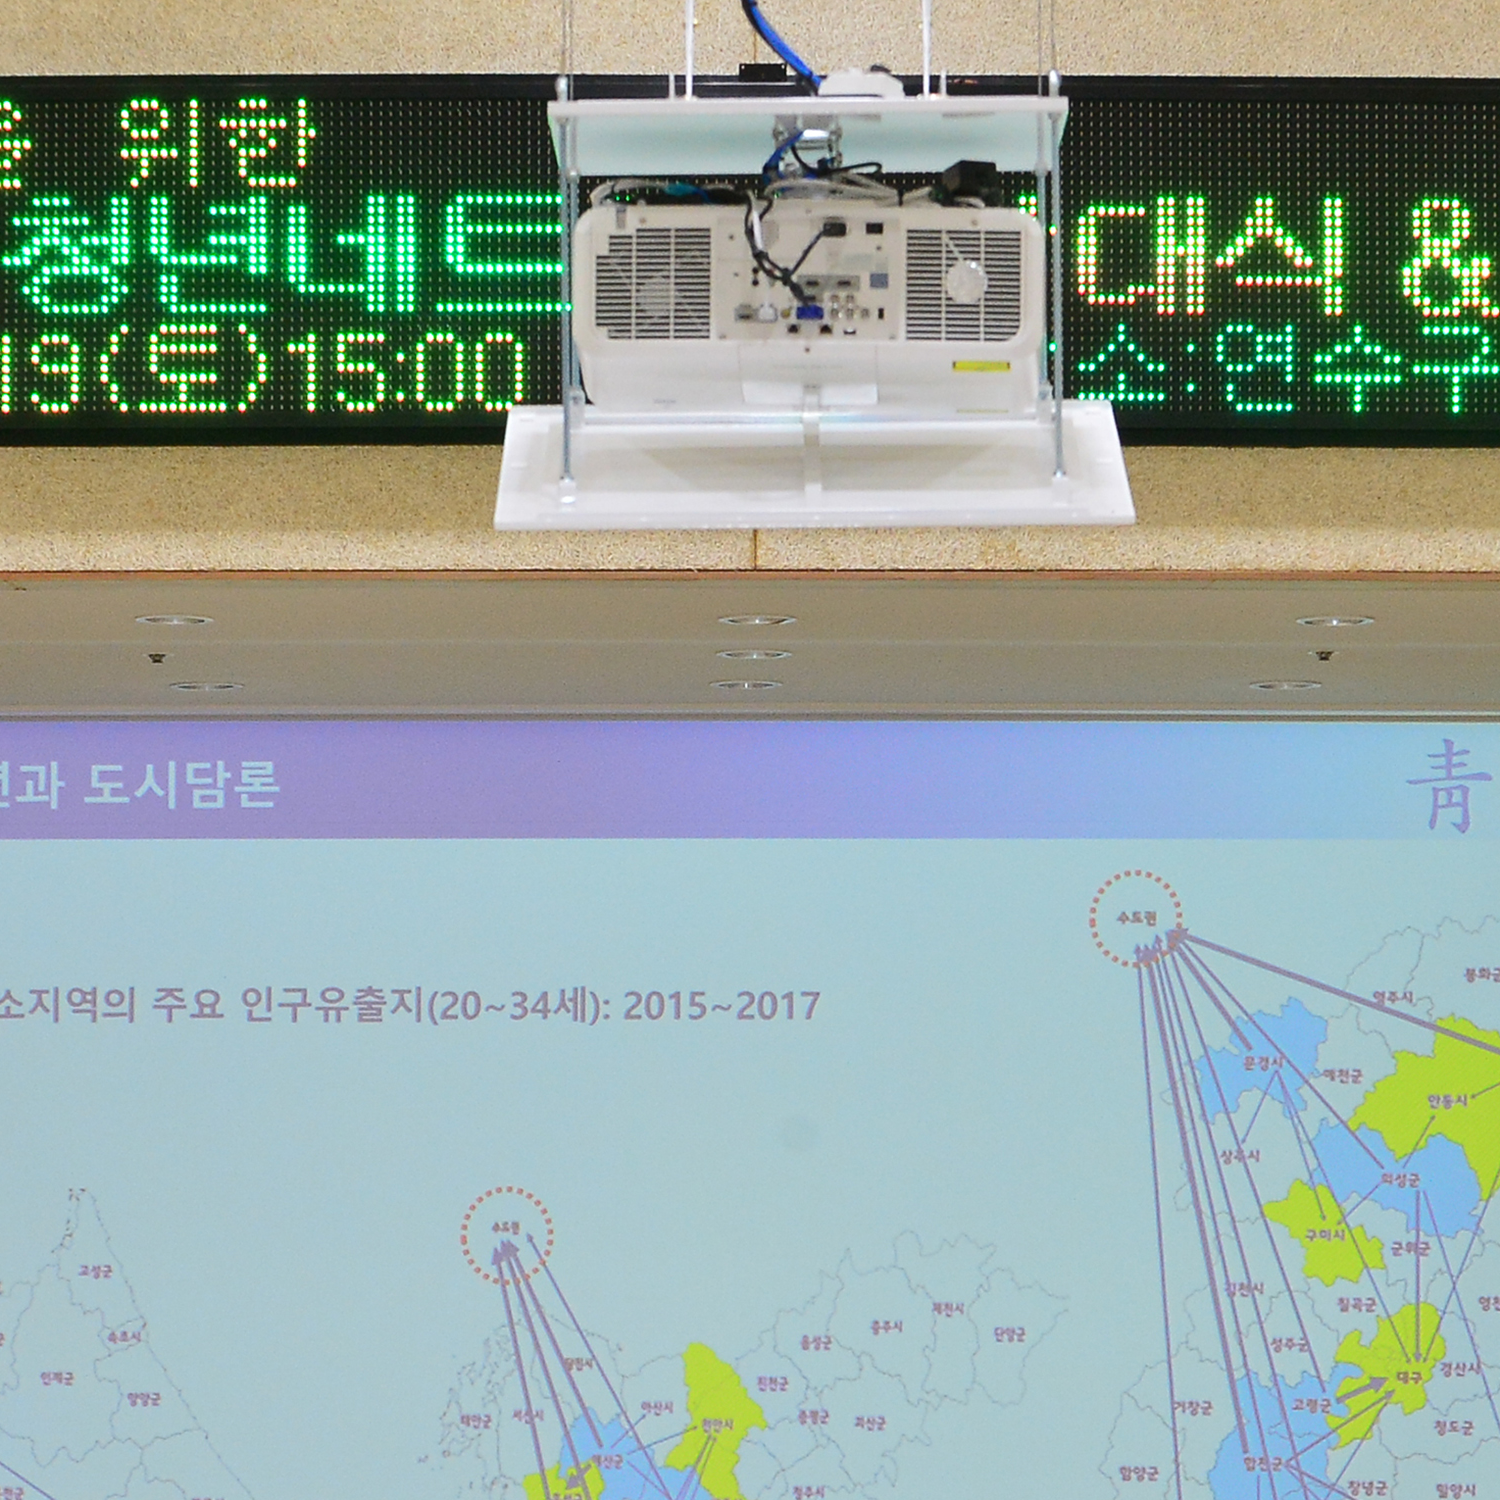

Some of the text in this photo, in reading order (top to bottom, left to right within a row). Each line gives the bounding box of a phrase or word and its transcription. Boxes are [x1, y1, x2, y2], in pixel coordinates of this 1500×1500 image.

[119, 97, 318, 188] 위한
[1018, 194, 1346, 318] 대식
[1402, 196, 1499, 318] &
[82, 759, 282, 811] 도시담론
[151, 986, 226, 1024] 주요
[240, 985, 612, 1027] 인구유출지(20~34세):
[623, 989, 821, 1021] 2015~2017
[1373, 990, 1414, 1005] 영주시
[1428, 1094, 1468, 1109] 안동시
[1305, 1229, 1345, 1242] 구미시
[1440, 1363, 1480, 1378] 경산시
[1434, 1420, 1475, 1437] 청도군
